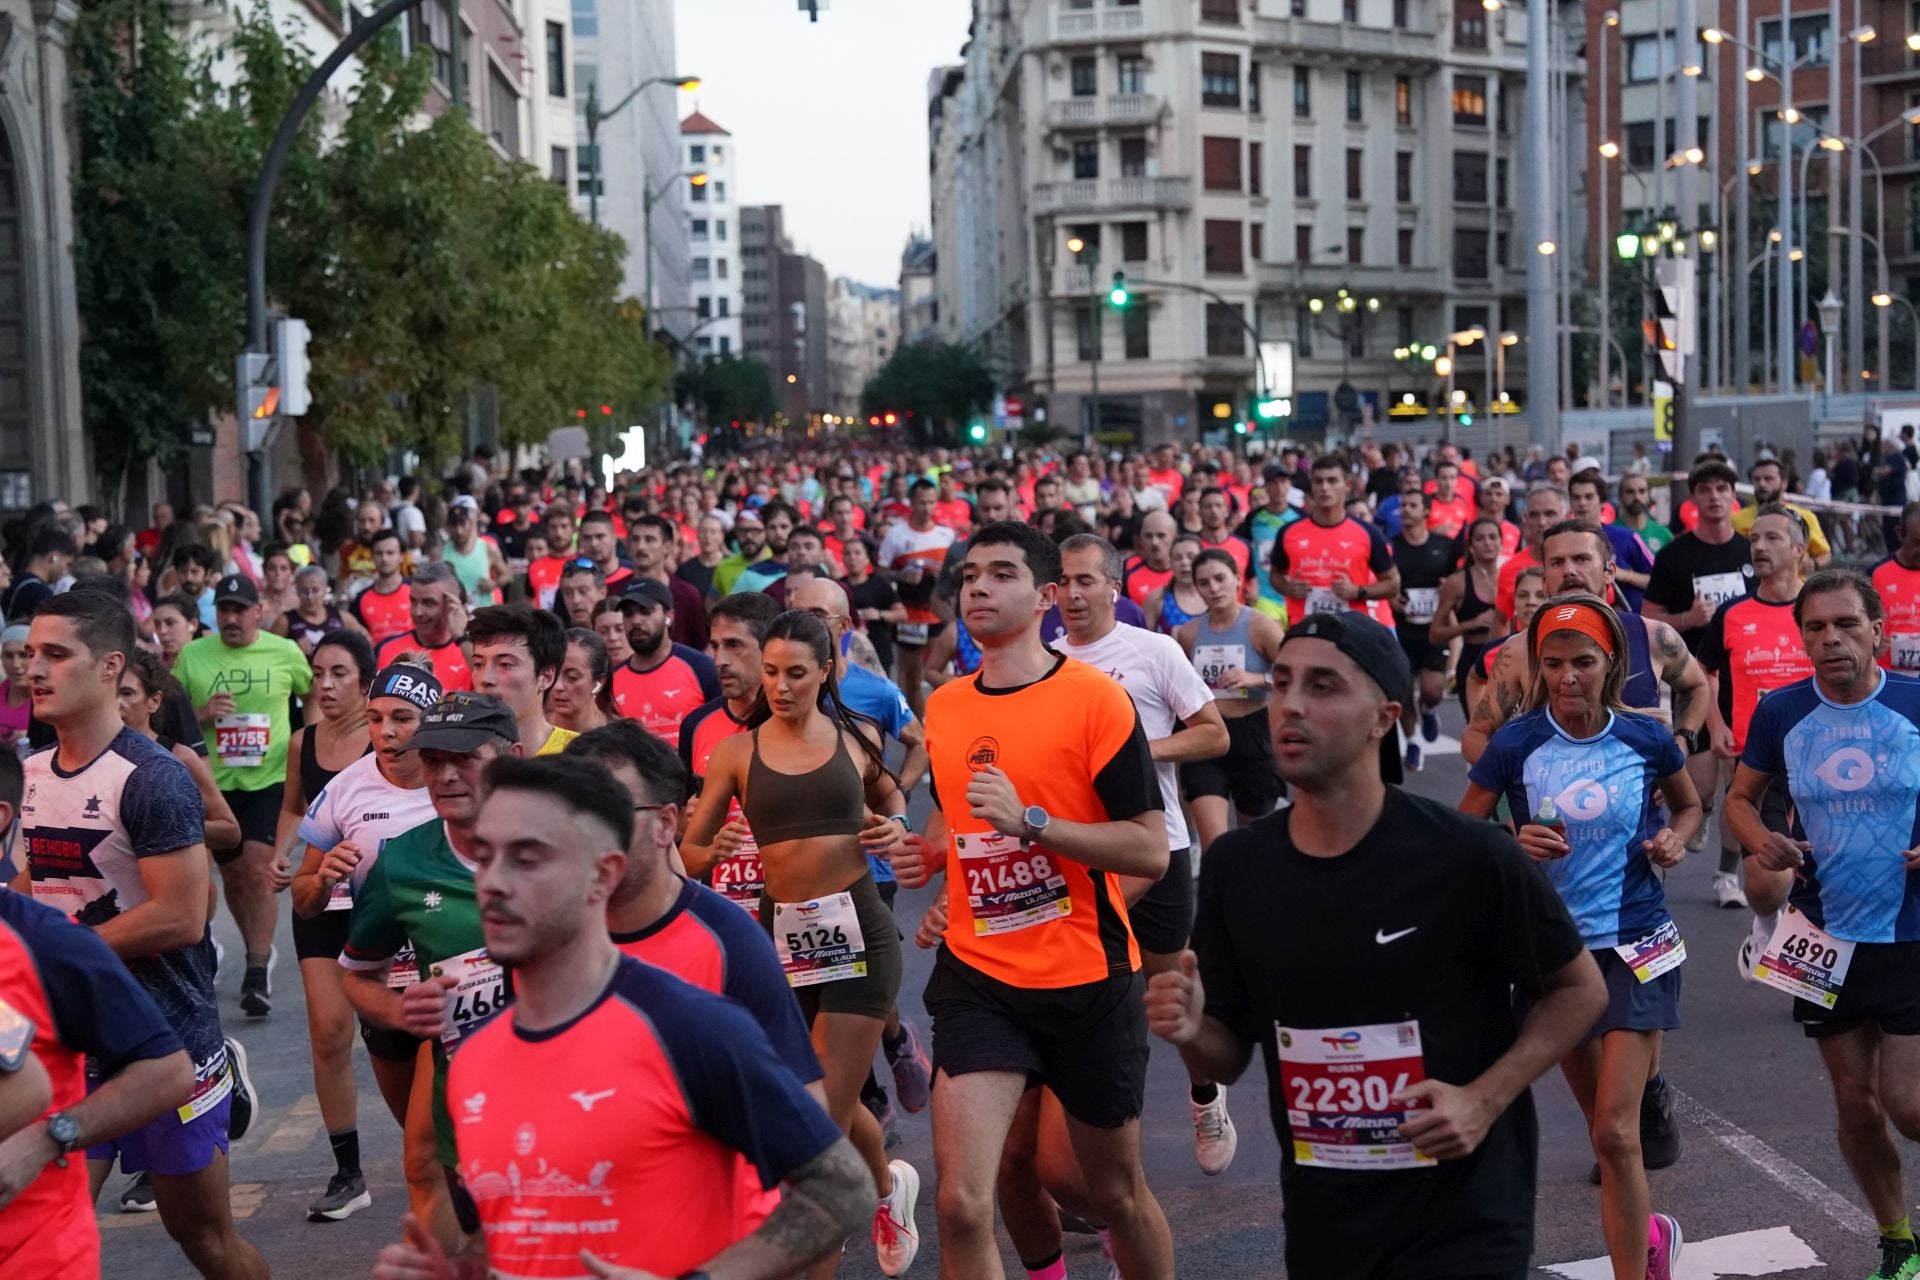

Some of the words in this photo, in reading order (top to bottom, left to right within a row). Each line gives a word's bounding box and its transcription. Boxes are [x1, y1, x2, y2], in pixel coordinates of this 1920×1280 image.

[220, 731, 267, 746] 21755
[31, 837, 82, 858] BEHOBIA
[968, 855, 1052, 895] 21488
[1063, 902, 1070, 910] 4
[786, 925, 847, 952] 5126
[1782, 934, 1838, 970] 4890
[1327, 1064, 1365, 1073] RUBEN
